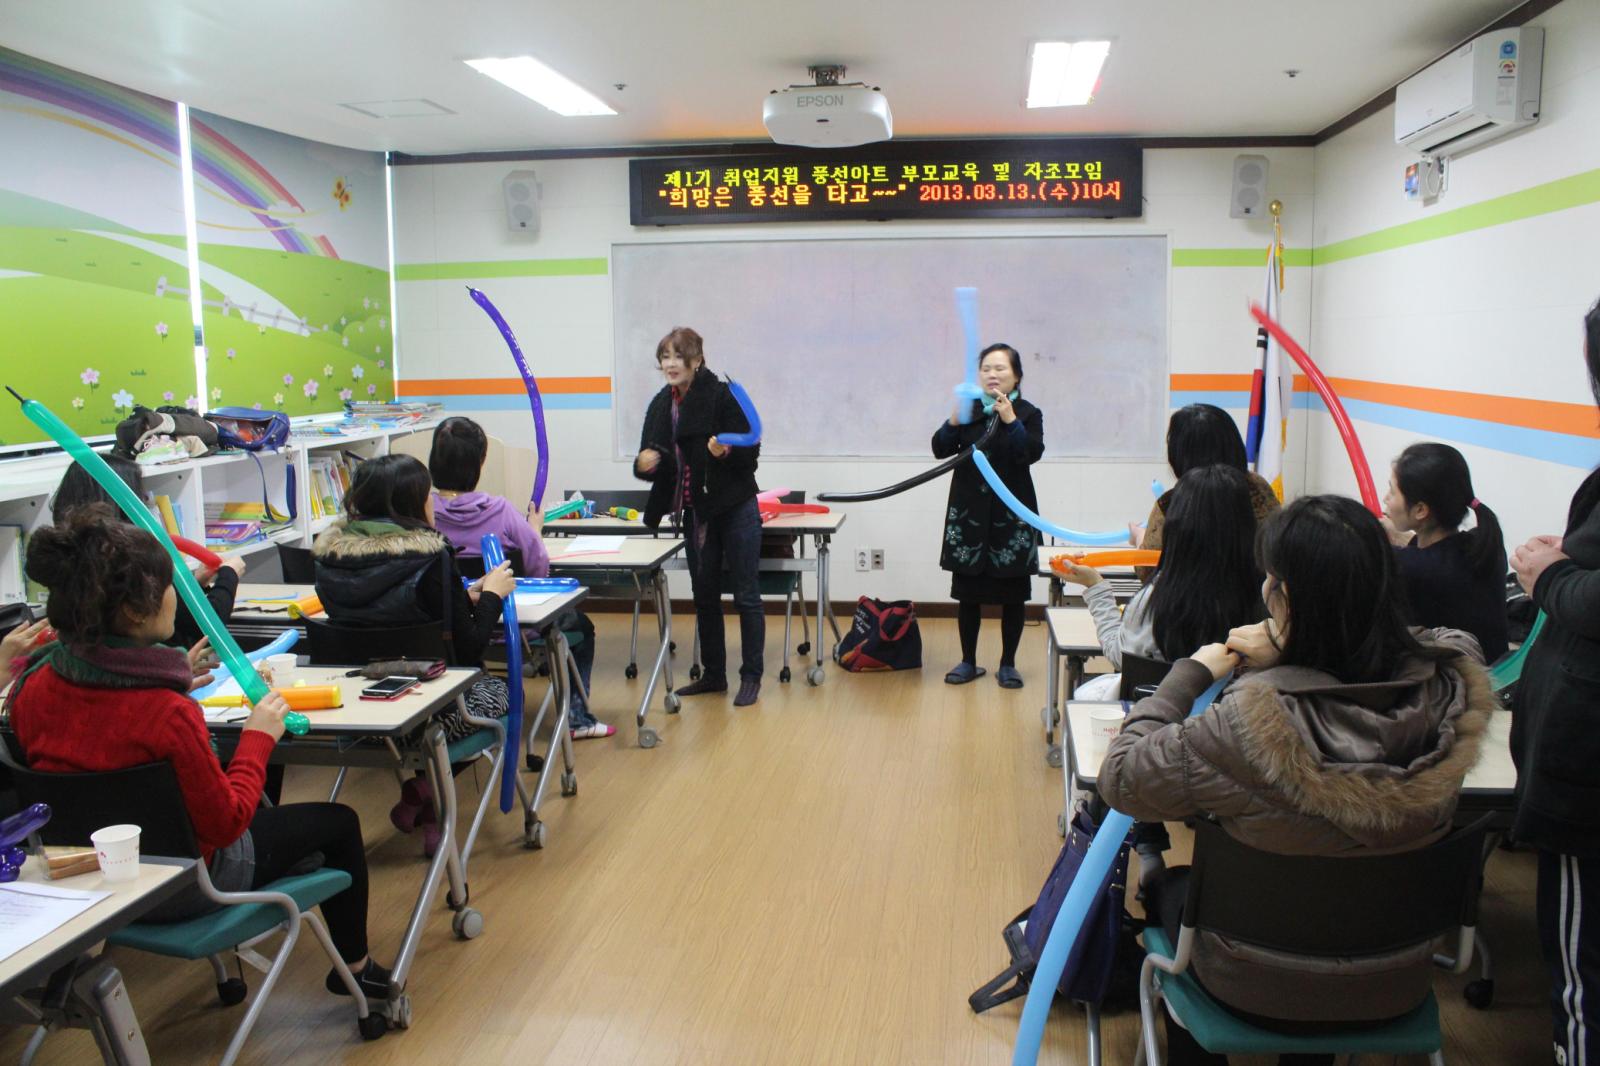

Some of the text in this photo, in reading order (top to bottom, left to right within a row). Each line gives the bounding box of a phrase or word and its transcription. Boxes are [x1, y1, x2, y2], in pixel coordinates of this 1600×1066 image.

[796, 95, 844, 108] EPSON
[664, 161, 1103, 188] 제1기 취업지원 풍선아트 부모교육 및 자조모임
[747, 184, 812, 207] 풍선을
